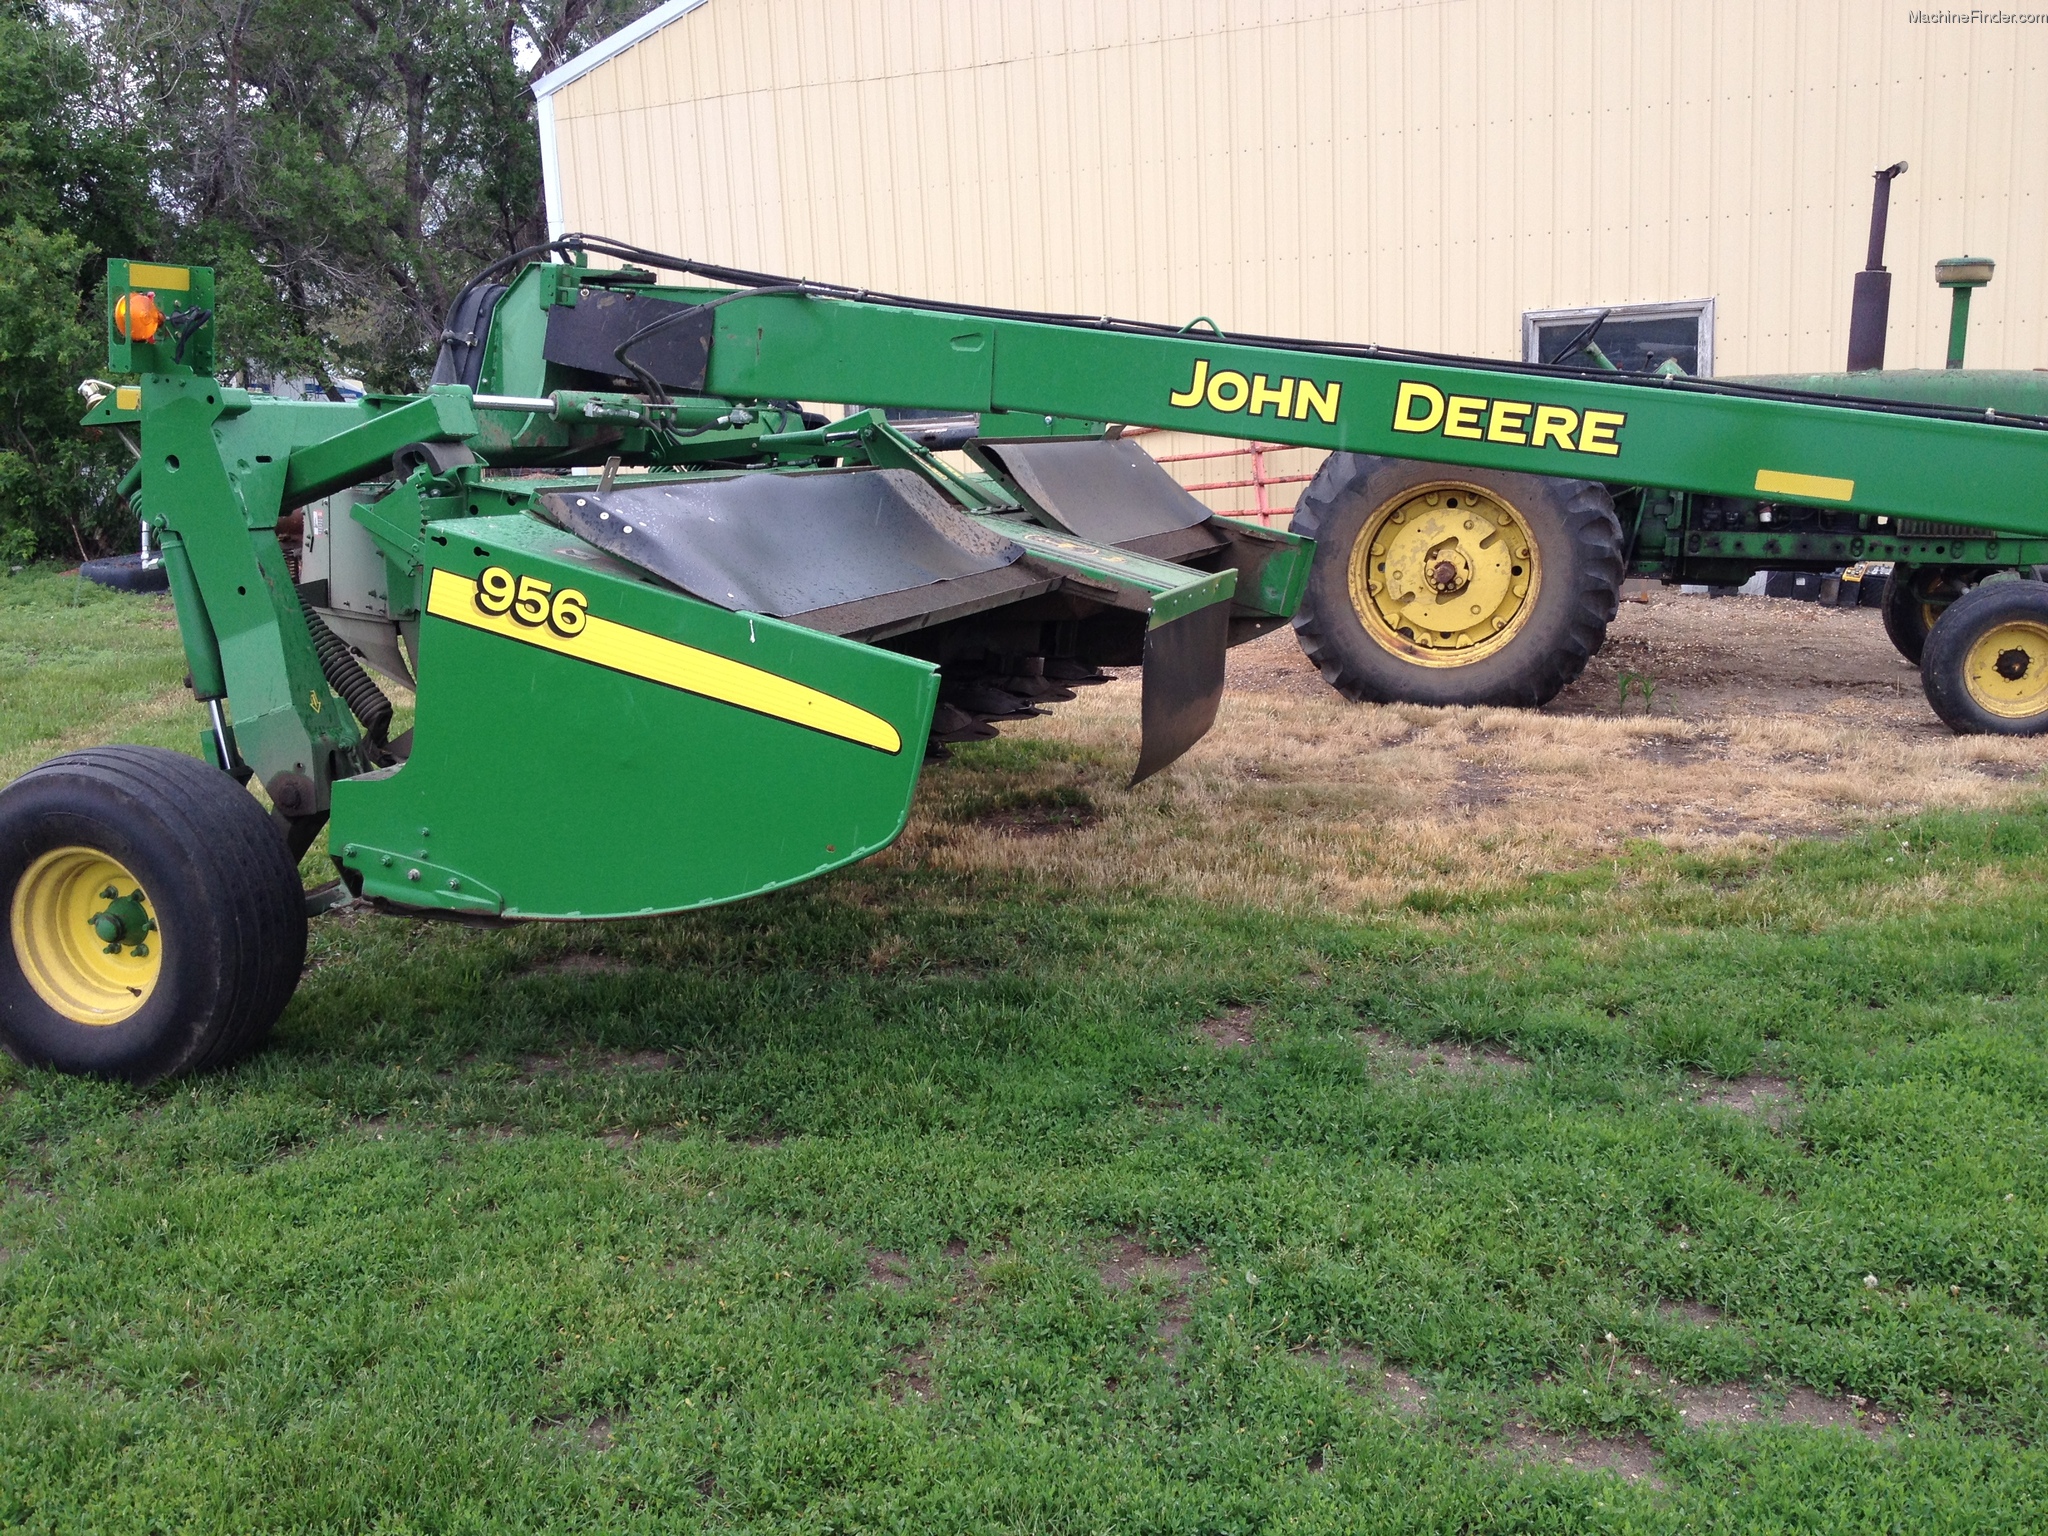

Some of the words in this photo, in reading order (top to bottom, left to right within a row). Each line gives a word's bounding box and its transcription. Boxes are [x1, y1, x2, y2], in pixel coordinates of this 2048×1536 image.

[1170, 358, 1342, 424] JOHN
[1392, 380, 1627, 457] DEERE
[475, 566, 588, 638] 956
